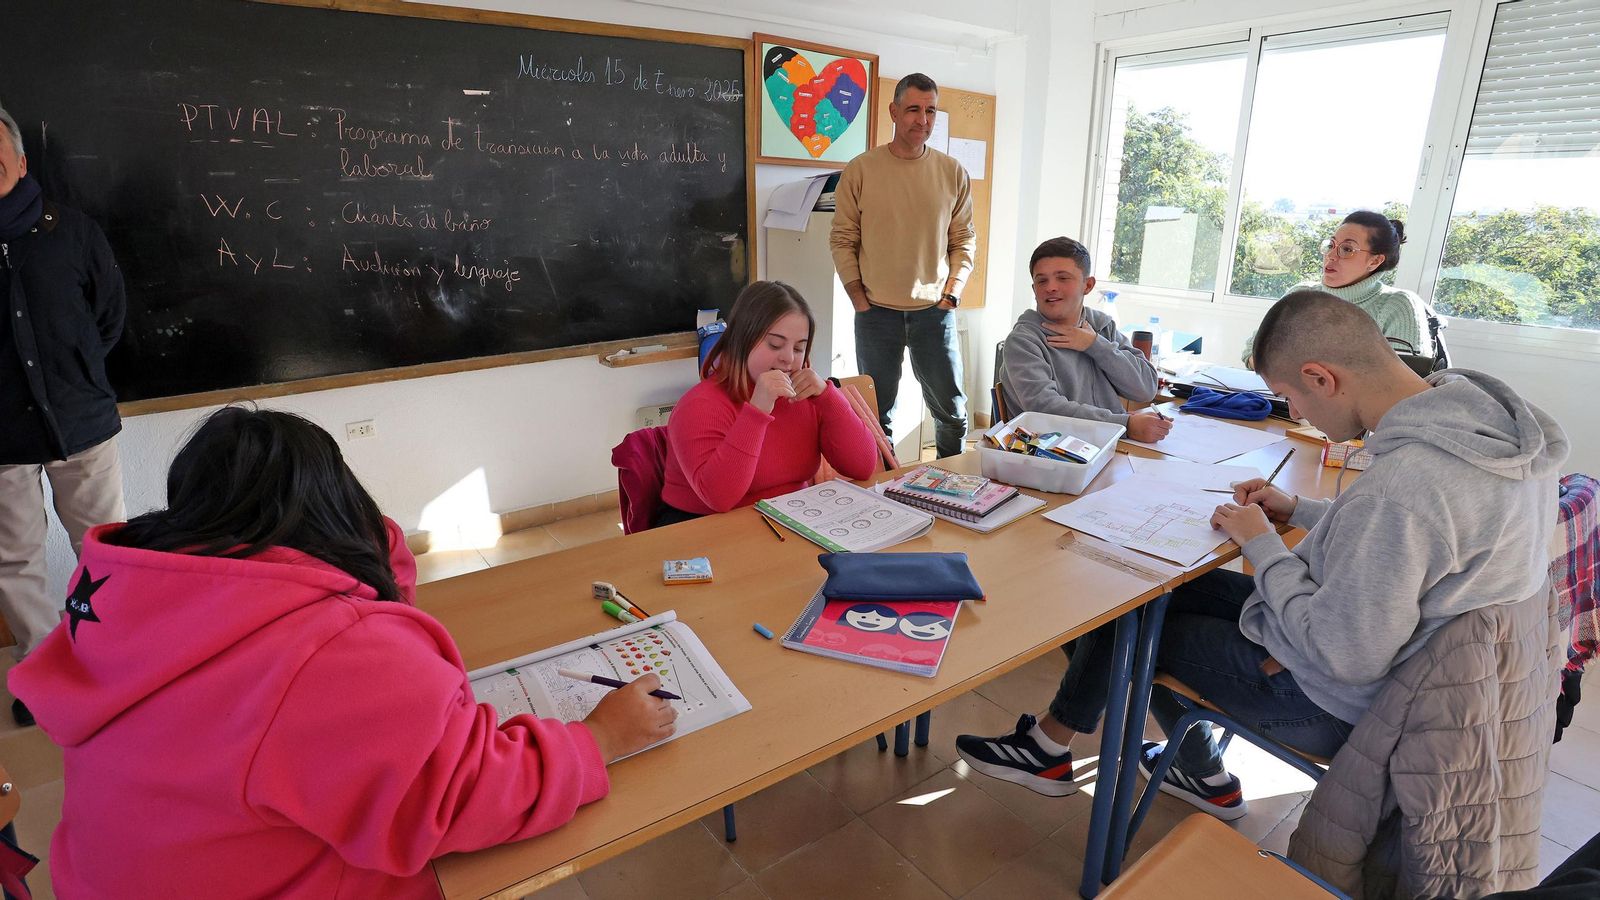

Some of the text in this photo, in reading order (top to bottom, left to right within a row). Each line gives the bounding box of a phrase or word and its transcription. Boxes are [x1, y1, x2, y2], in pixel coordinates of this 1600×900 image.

[605, 56, 626, 86] 15
[633, 63, 650, 91] de
[655, 69, 696, 99] Enero
[329, 106, 432, 150] Programa
[441, 117, 466, 151] de
[572, 149, 585, 161] a
[593, 143, 611, 161] la
[618, 142, 649, 161] vida
[659, 143, 710, 164] adulta
[718, 152, 727, 173] y
[340, 147, 434, 179] laboral
[341, 200, 414, 228] Cuarto
[419, 212, 438, 231] de
[430, 265, 446, 286] y
[453, 252, 522, 293] lenguaje
